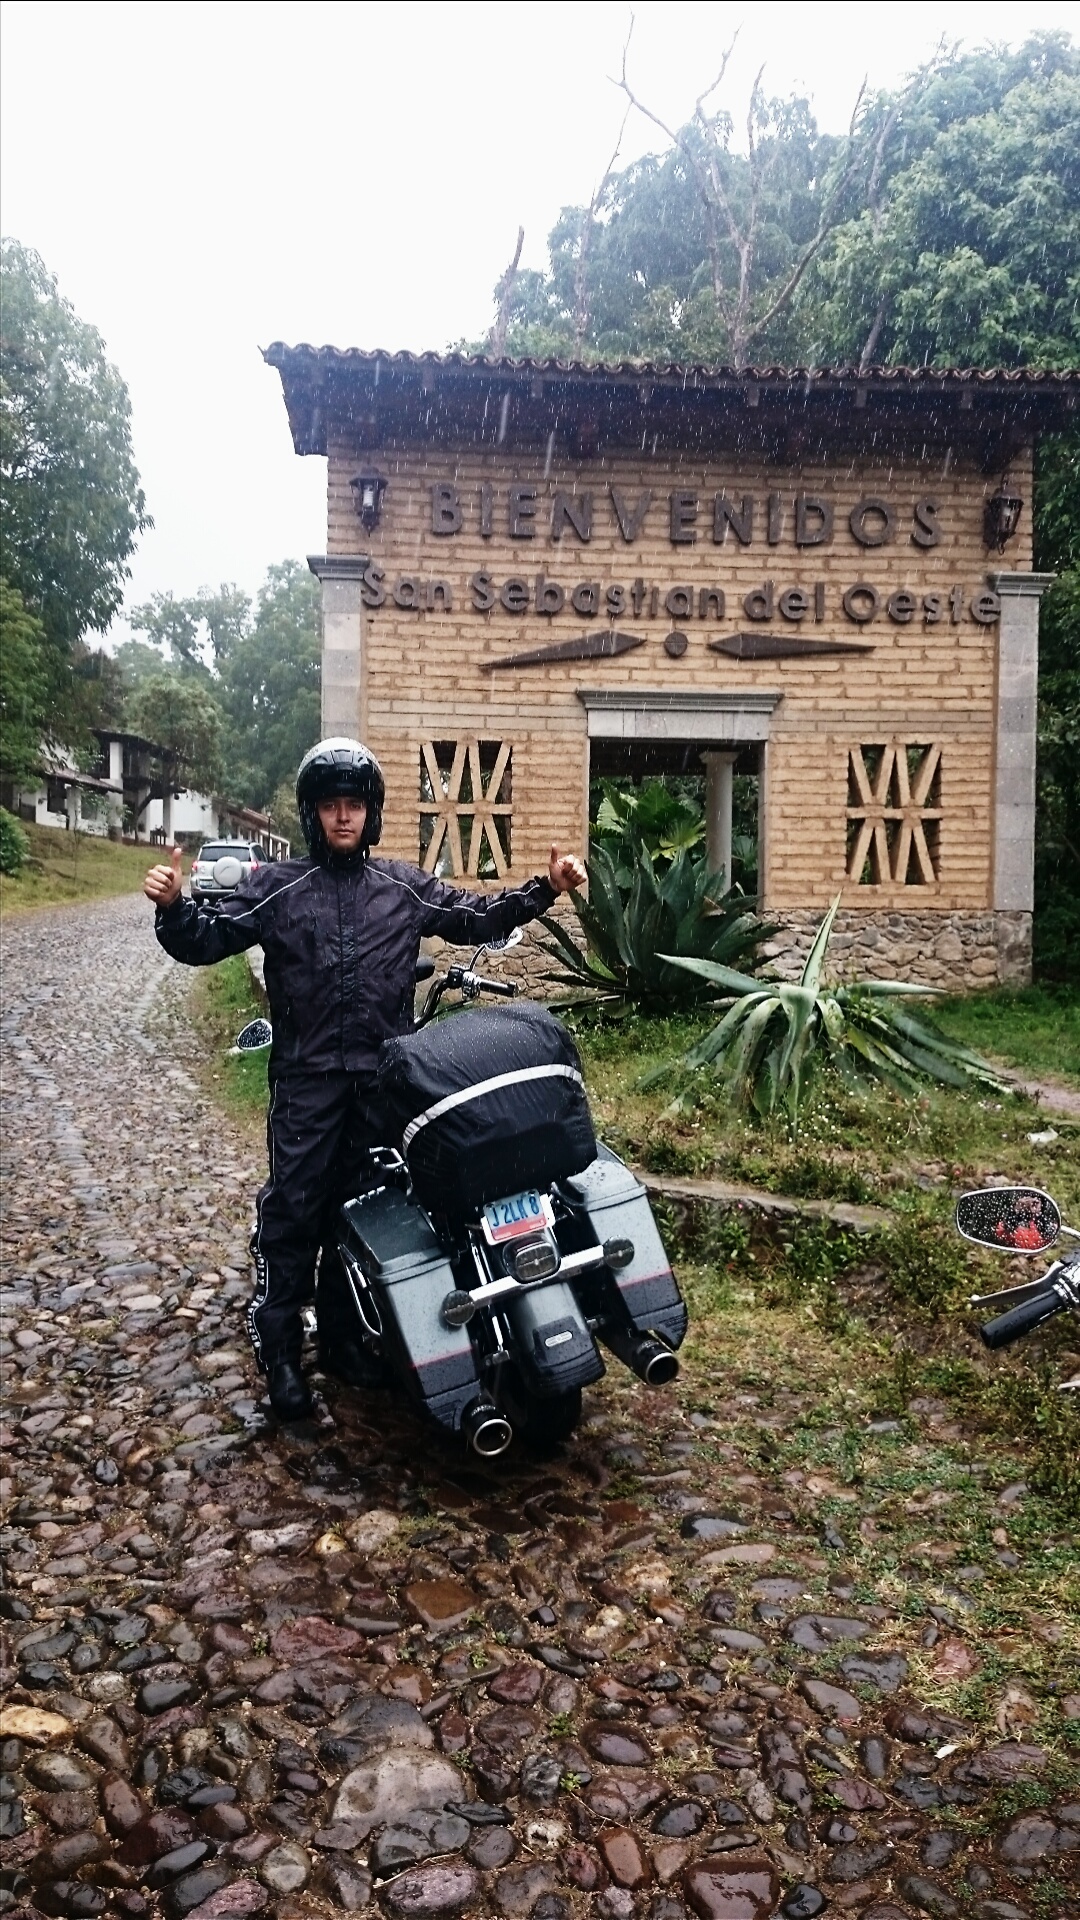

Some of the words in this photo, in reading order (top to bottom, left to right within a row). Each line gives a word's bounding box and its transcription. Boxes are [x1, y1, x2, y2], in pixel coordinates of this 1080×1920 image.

[431, 483, 940, 547] BIENVENIDOS
[361, 566, 452, 611] San
[471, 570, 726, 619] Sebastian
[743, 580, 826, 621] del
[843, 582, 1000, 624] Oeste
